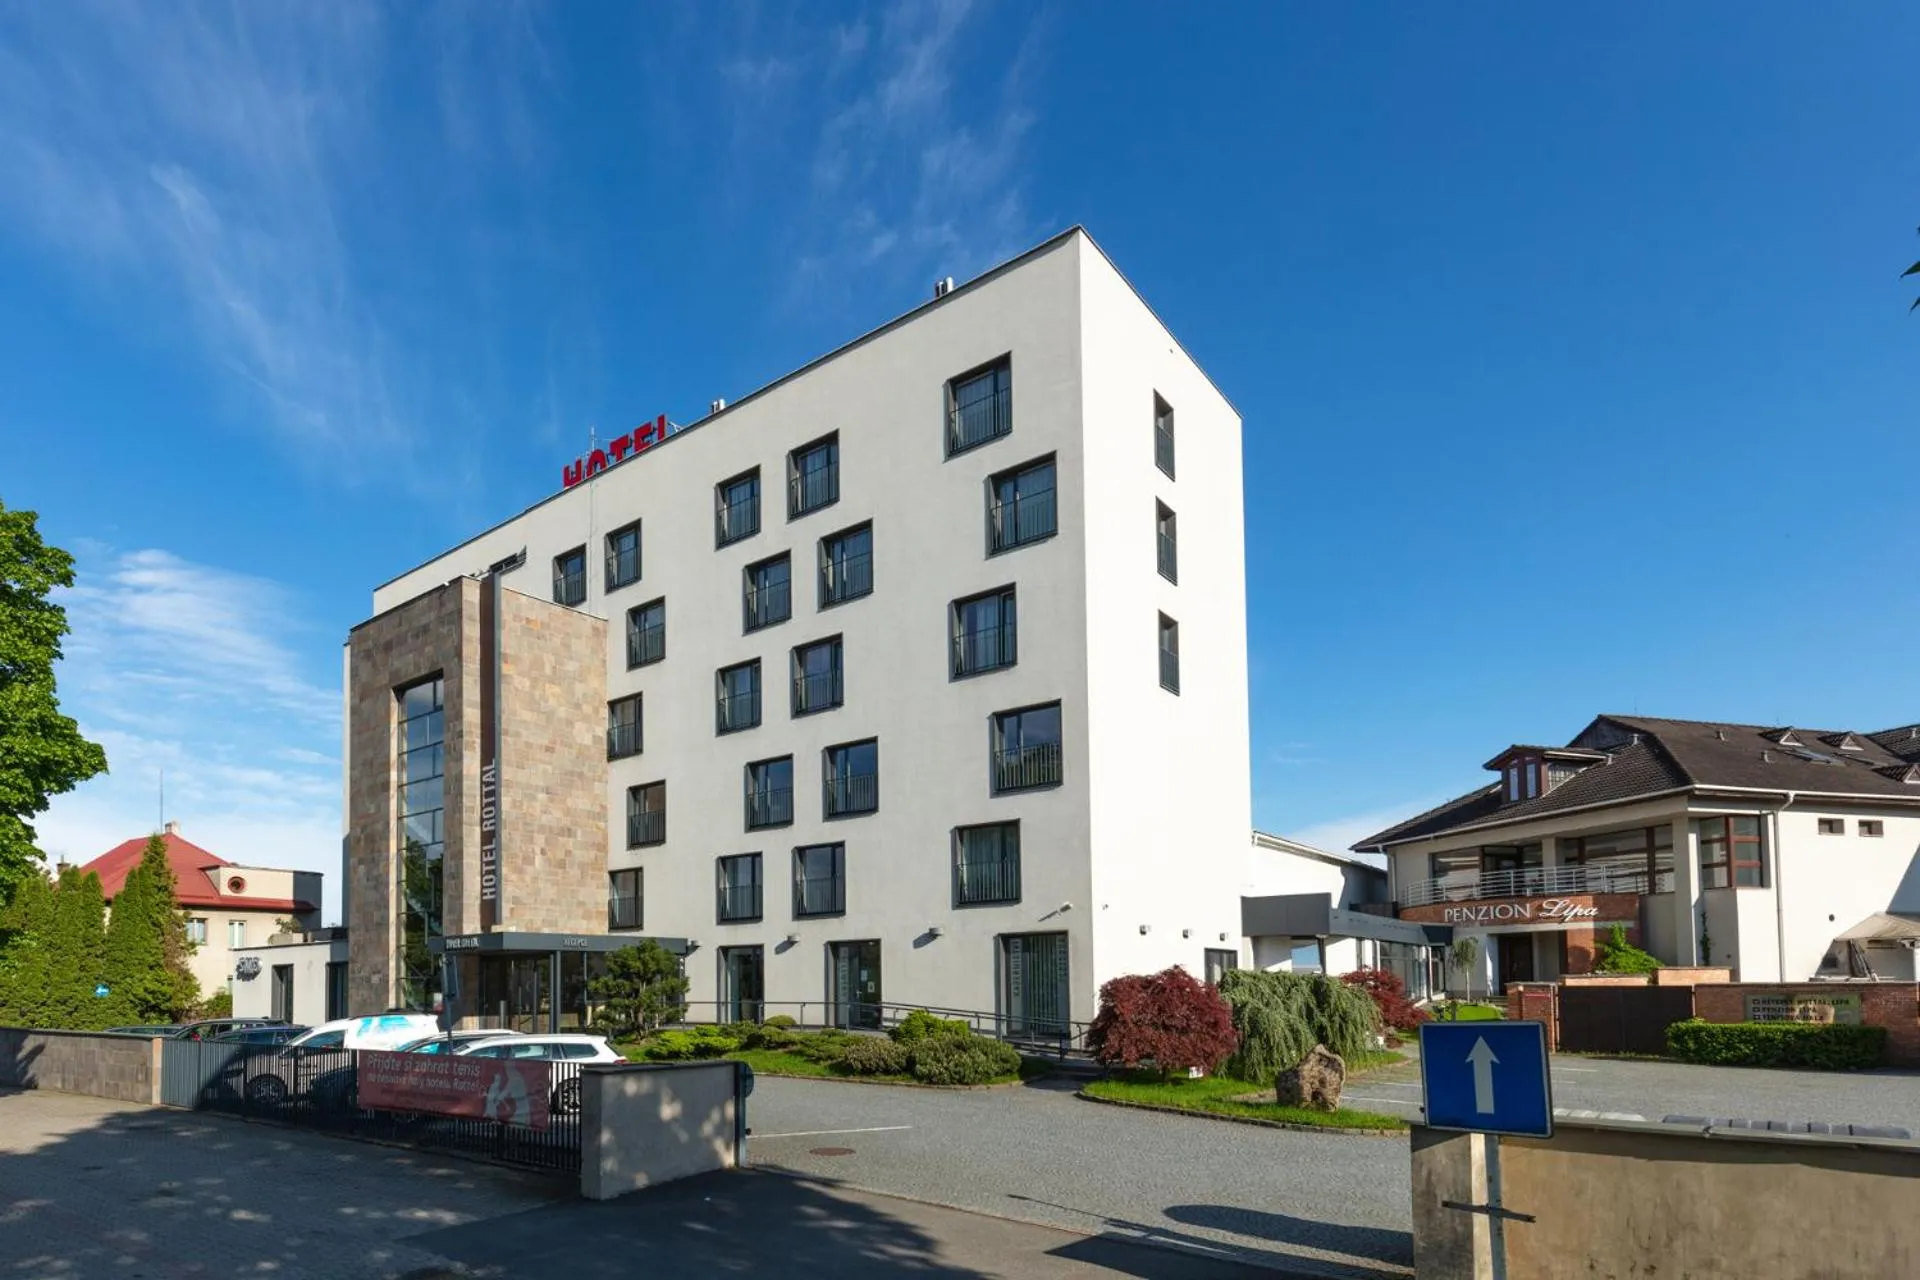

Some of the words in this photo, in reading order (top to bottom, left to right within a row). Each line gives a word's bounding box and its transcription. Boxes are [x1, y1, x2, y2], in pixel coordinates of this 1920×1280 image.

[482, 758, 496, 831] ROTTAL
[482, 838, 496, 900] HOTEL
[1444, 903, 1531, 922] PENZION
[453, 1059, 481, 1077] tenis
